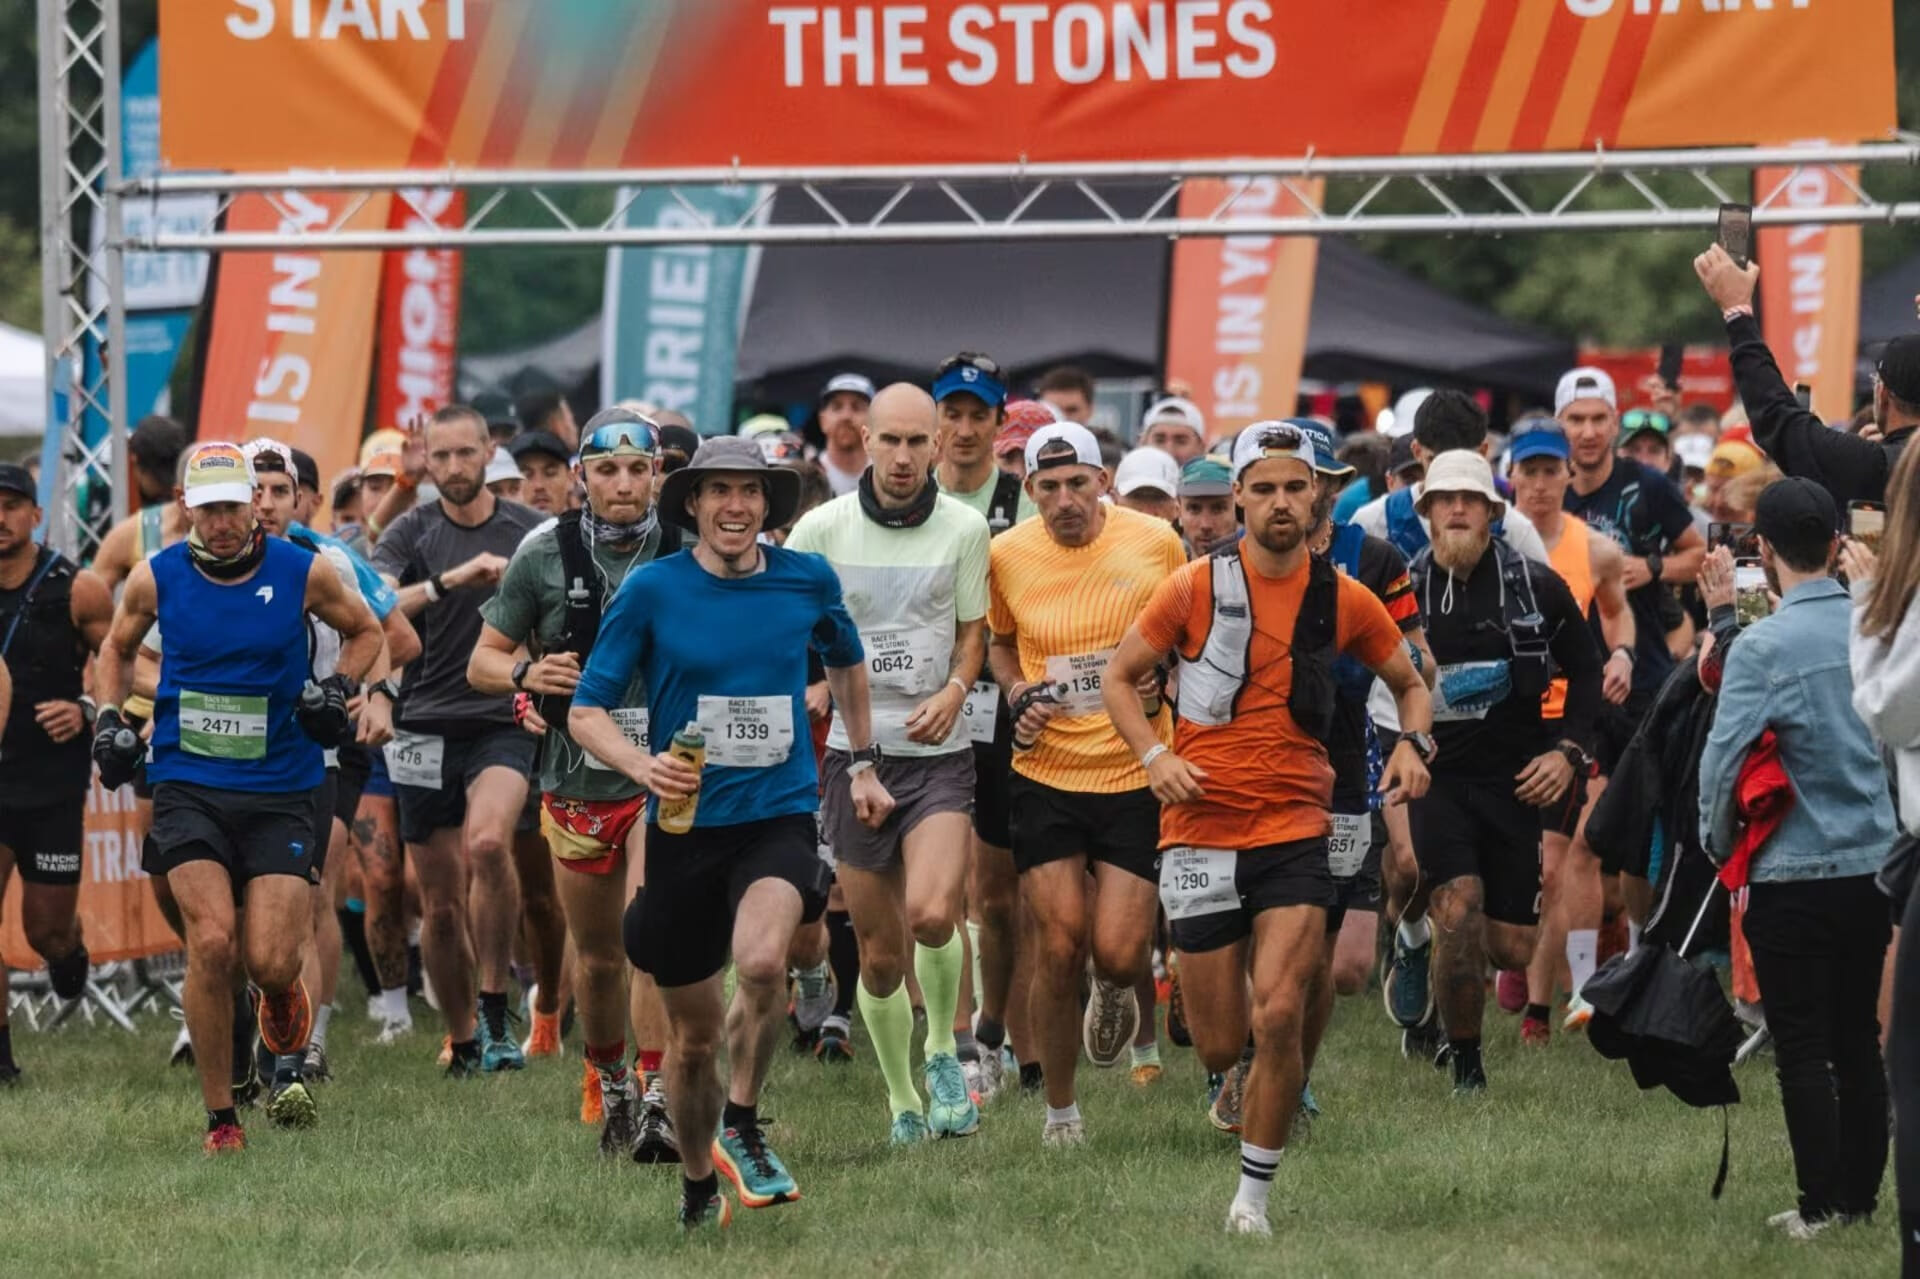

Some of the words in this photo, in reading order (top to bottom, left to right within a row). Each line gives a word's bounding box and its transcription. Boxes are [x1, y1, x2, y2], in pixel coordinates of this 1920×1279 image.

[768, 6, 929, 87] THE
[947, 0, 1277, 86] STONES
[265, 253, 322, 335] IN
[1789, 256, 1826, 314] IN
[1214, 295, 1266, 354] IN
[247, 352, 311, 423] IS
[1212, 363, 1263, 418] IS
[872, 655, 914, 673] 0642
[1072, 675, 1101, 692] 136
[742, 707, 768, 715] STONES
[202, 717, 241, 735] 2471
[726, 723, 769, 740] 1339
[624, 732, 649, 748] 39
[392, 748, 422, 766] 1478
[1328, 837, 1356, 853] 651
[88, 829, 151, 883] TRA
[1174, 872, 1209, 891] 1290
